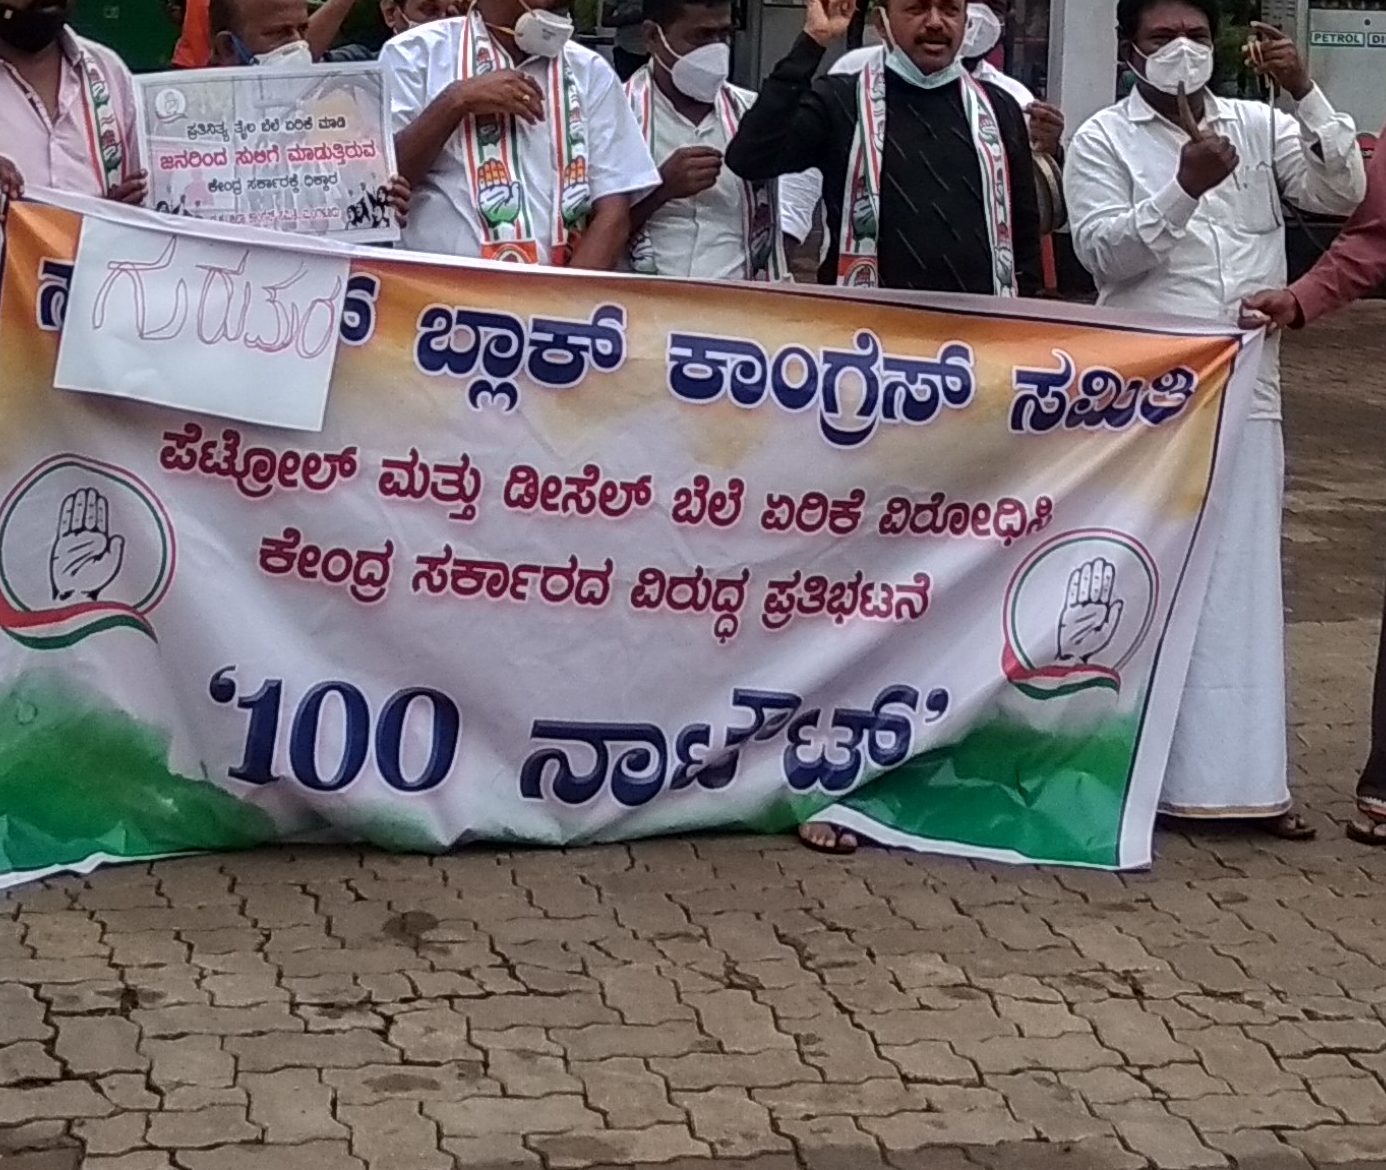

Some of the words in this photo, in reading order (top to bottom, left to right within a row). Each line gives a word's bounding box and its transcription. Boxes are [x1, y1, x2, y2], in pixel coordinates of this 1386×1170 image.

[1314, 33, 1360, 44] PETROL
[187, 120, 230, 142] ಪ್ರತಿನಿತ್ಯ
[233, 118, 256, 140] ತೈಲ
[261, 117, 280, 132] ಬೆಲೆ
[318, 114, 346, 129] ಮಾಡಿ
[160, 148, 228, 170] ಜನರಿಂದ
[288, 140, 376, 166] ಮಾಡುತ್ತಿರುವ
[208, 177, 242, 195] ಕೇಂದ್ರ
[247, 174, 300, 194] ಸರ್ಕಾರಕ್ಕೆ
[303, 172, 338, 192] ಧಿಕ್ಕಾರ
[417, 303, 627, 412] ಬ್ಲಾಕ್
[666, 331, 975, 448] ಕಾಂಗ್ರೆಸ್
[1011, 348, 1197, 432] ಸಮಿತಿ
[160, 422, 357, 497] ಪೆಟ್ರೋಲ್
[378, 449, 481, 521] ಮತ್ತು
[505, 465, 651, 519] ಡೀಸೆಲ್
[671, 475, 744, 528] ಬೆಲೆ
[760, 487, 865, 534] ಏರಿಕೆ
[879, 492, 1054, 546] ವಿರೋಧಿಸಿ
[260, 527, 394, 604] ಕೇಂದ್ರ
[412, 544, 613, 607] ಸರ್ಕಾರದ
[631, 561, 750, 646] ವಿರುದ್ಧ
[763, 570, 932, 633] ಪ್ರತಿಭಟನೆ
